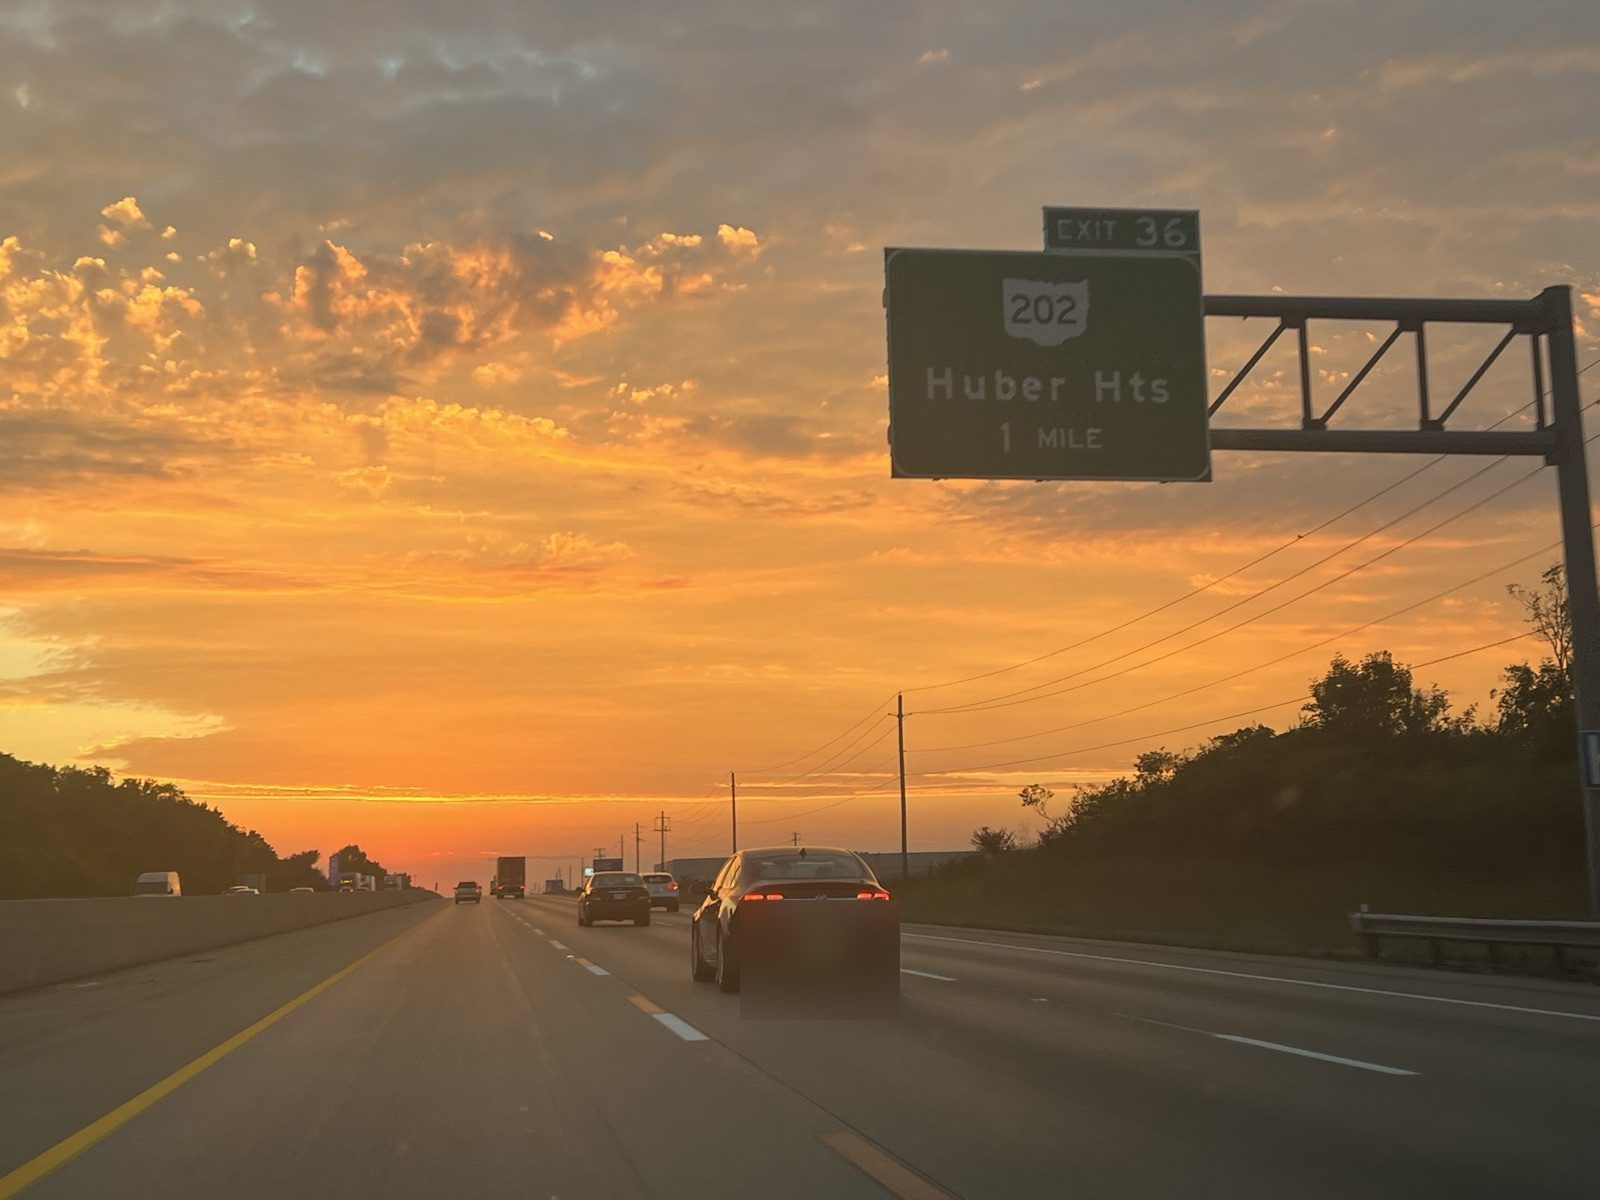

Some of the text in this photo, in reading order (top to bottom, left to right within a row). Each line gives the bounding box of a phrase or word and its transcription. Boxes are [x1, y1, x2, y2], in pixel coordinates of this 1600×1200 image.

[1057, 217, 1187, 247] EXIT 36
[1010, 294, 1077, 325] 202
[926, 367, 1170, 404] Huber Hts
[1001, 422, 1103, 452] 1 MILE
